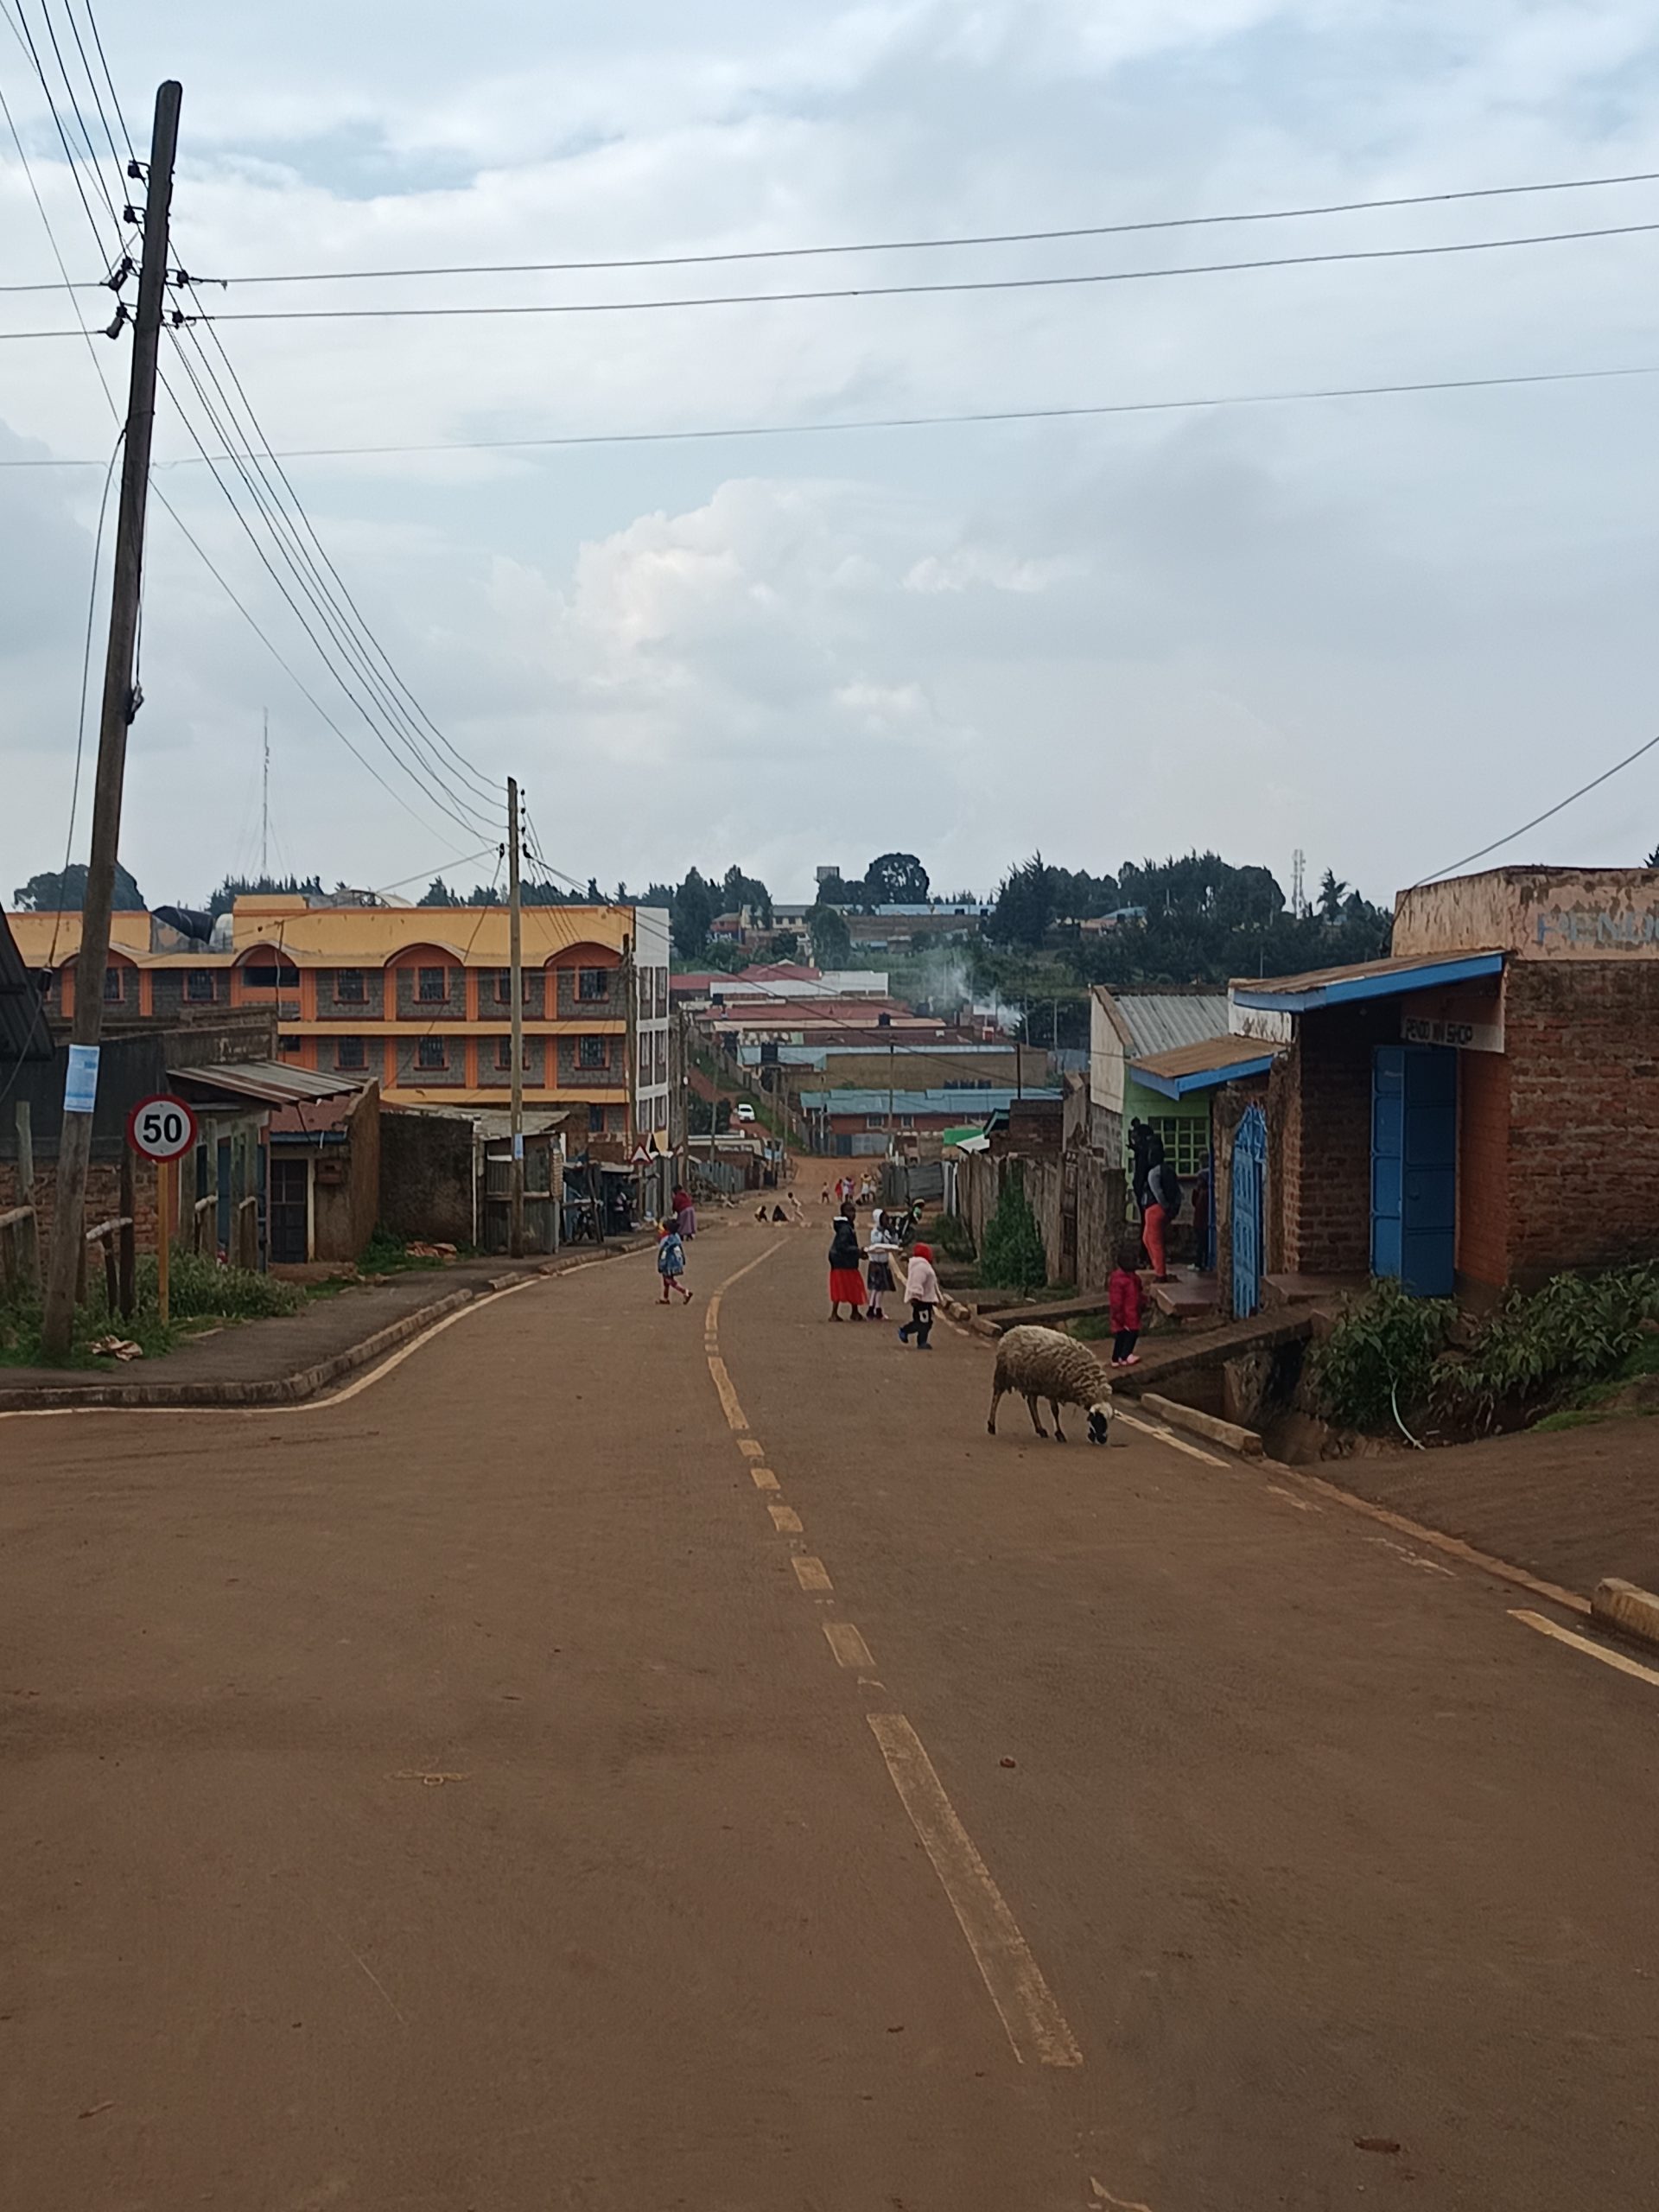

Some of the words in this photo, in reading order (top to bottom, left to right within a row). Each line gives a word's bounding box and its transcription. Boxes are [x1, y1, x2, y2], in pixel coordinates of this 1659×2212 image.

[1537, 911, 1659, 942] PEND
[1446, 1023, 1473, 1045] SHOP
[143, 1113, 182, 1144] 50
